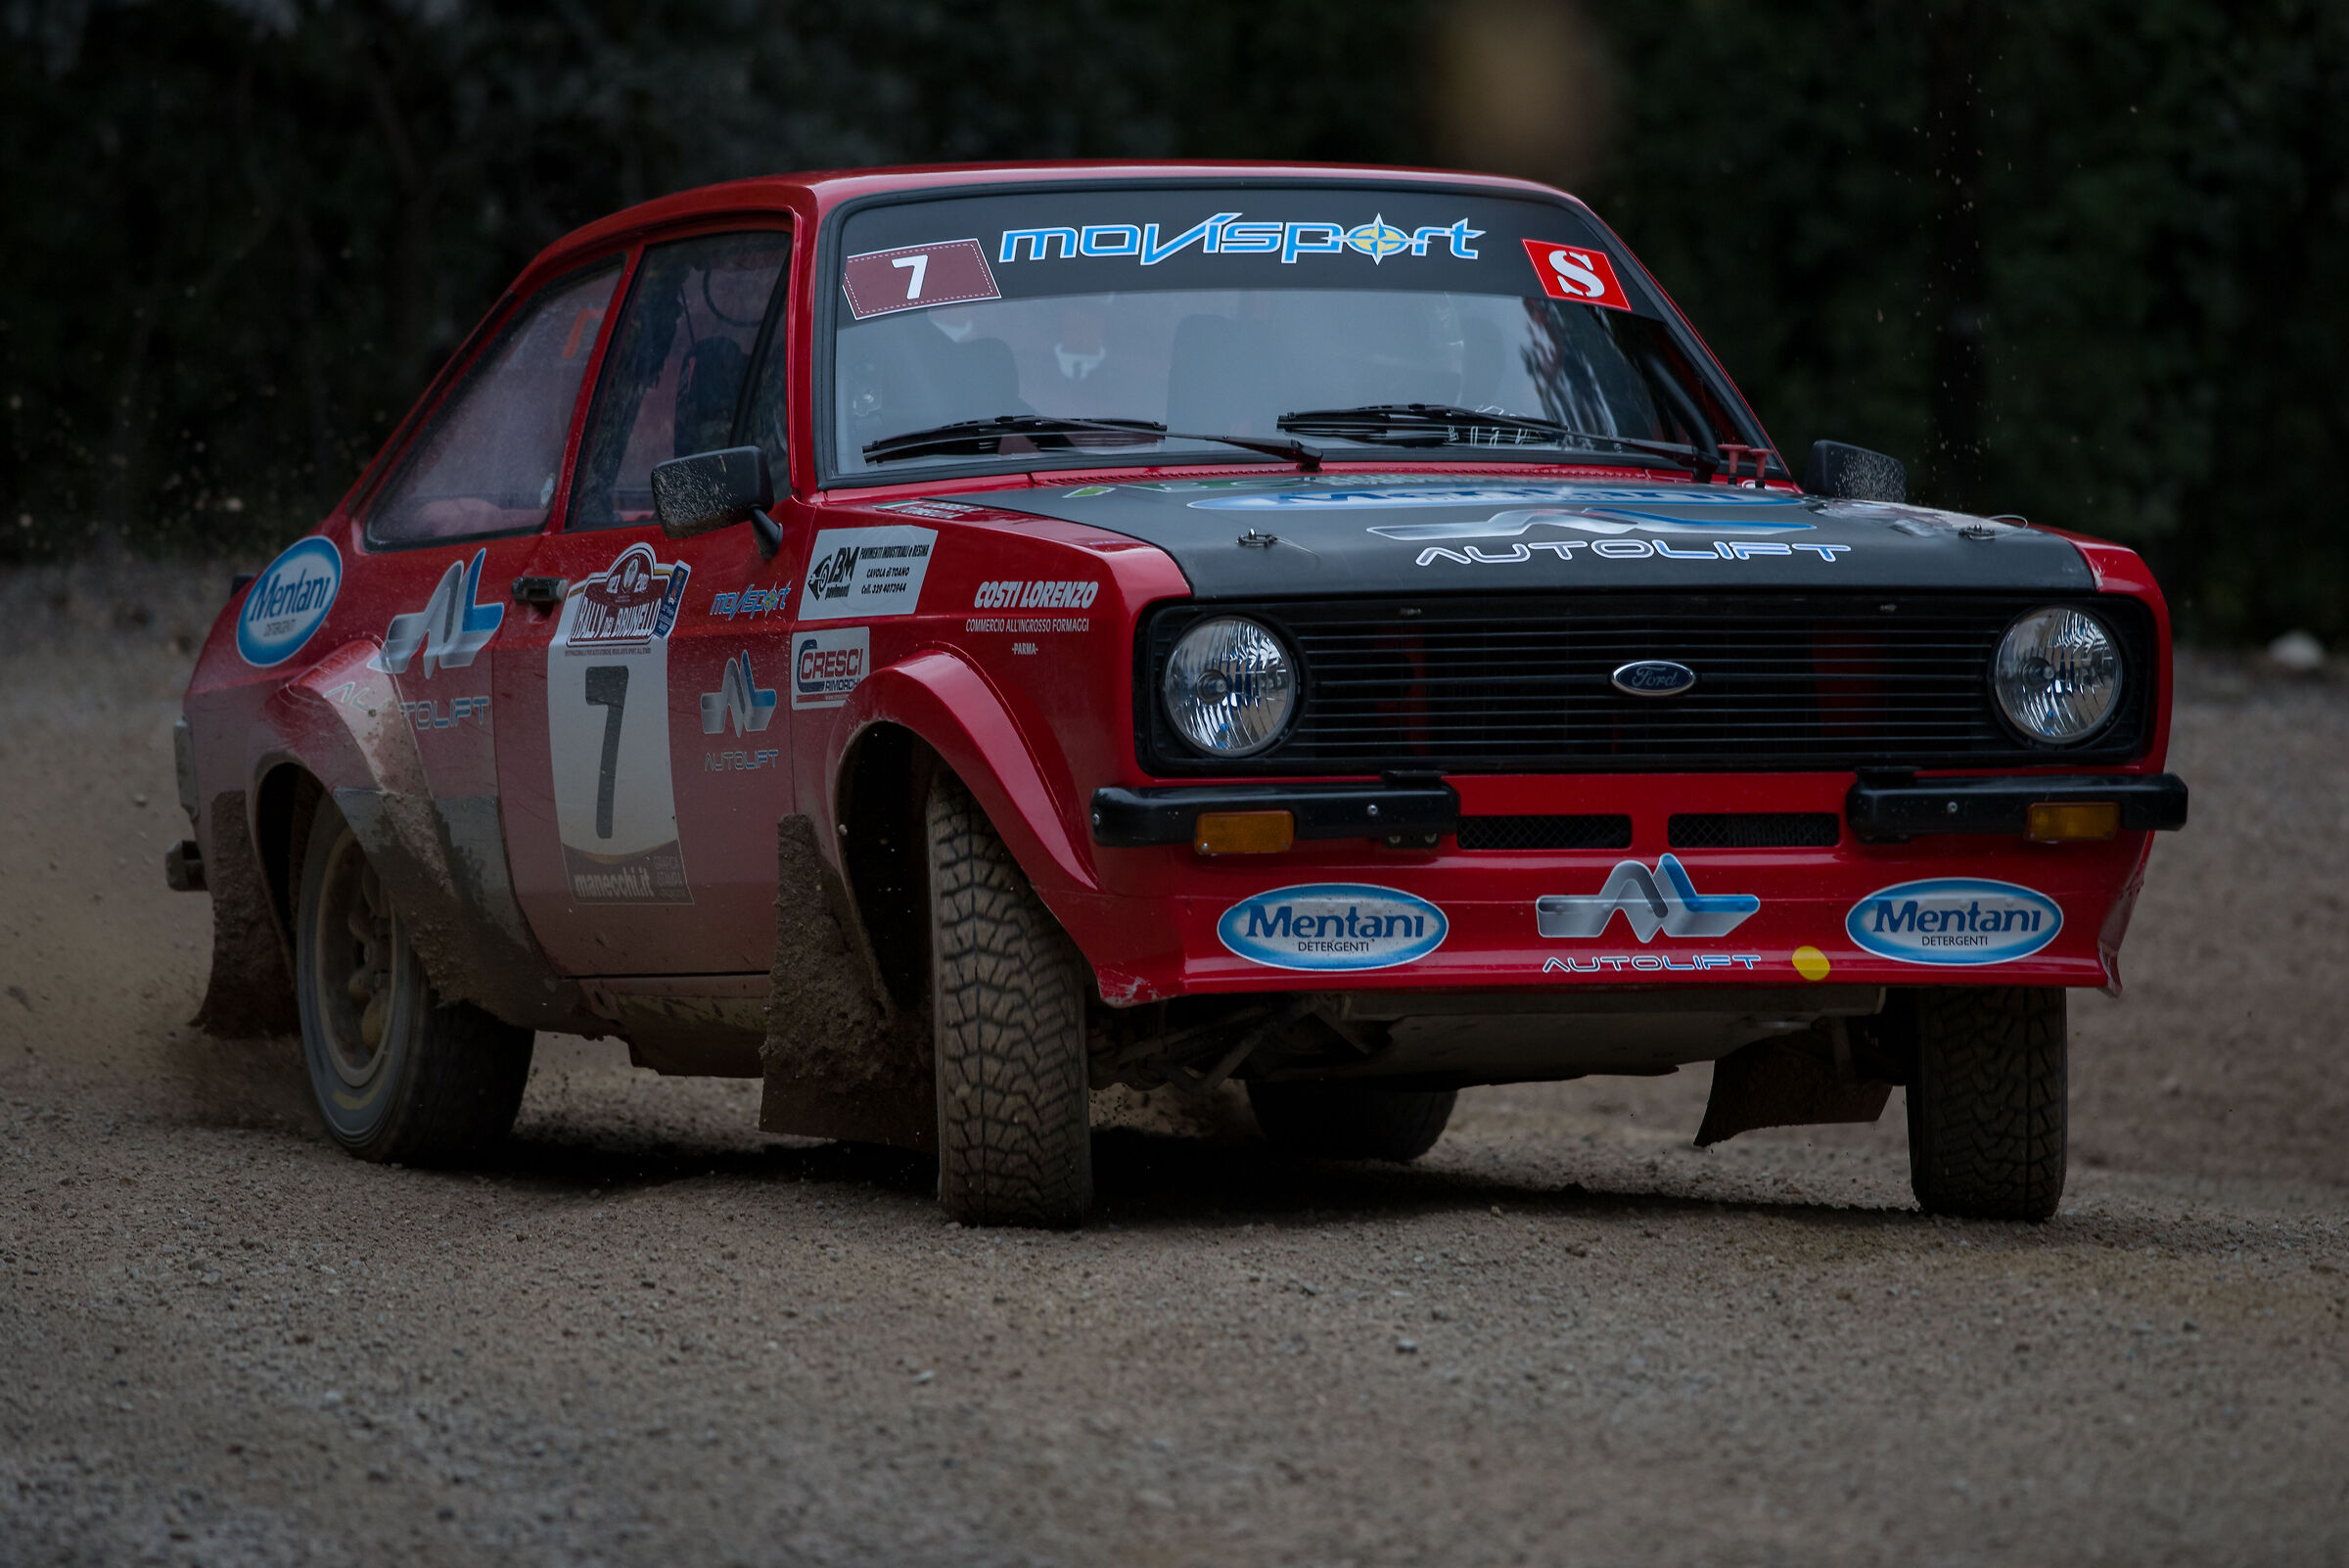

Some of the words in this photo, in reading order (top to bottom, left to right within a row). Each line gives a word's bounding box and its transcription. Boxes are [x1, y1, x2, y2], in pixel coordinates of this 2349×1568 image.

[892, 254, 928, 300] 7
[1548, 250, 1605, 298] S
[1415, 538, 1852, 566] AUTOLIFT
[866, 568, 886, 578] CAVOLA
[892, 566, 910, 577] TOANO
[249, 568, 331, 622] Mentani
[974, 580, 1024, 610] COSTI
[1019, 580, 1099, 609] LORENZO
[572, 597, 608, 639] RALLY
[611, 596, 663, 638] BRUNELLO
[965, 619, 1005, 633] COMMERCIO
[1052, 619, 1089, 633] FORMAGGI
[801, 648, 863, 680] CRESCI
[1632, 666, 1681, 687] Ford
[585, 666, 629, 839] 7
[704, 749, 779, 772] AUTOLIFT
[574, 865, 655, 898] manecchi.it
[1246, 904, 1424, 938] Mentani
[1873, 899, 2042, 933] Mentani
[1298, 942, 1369, 951] DETERGENTI
[1921, 935, 1988, 945] DETERGENTI
[1543, 954, 1761, 973] AUTOLIFT
